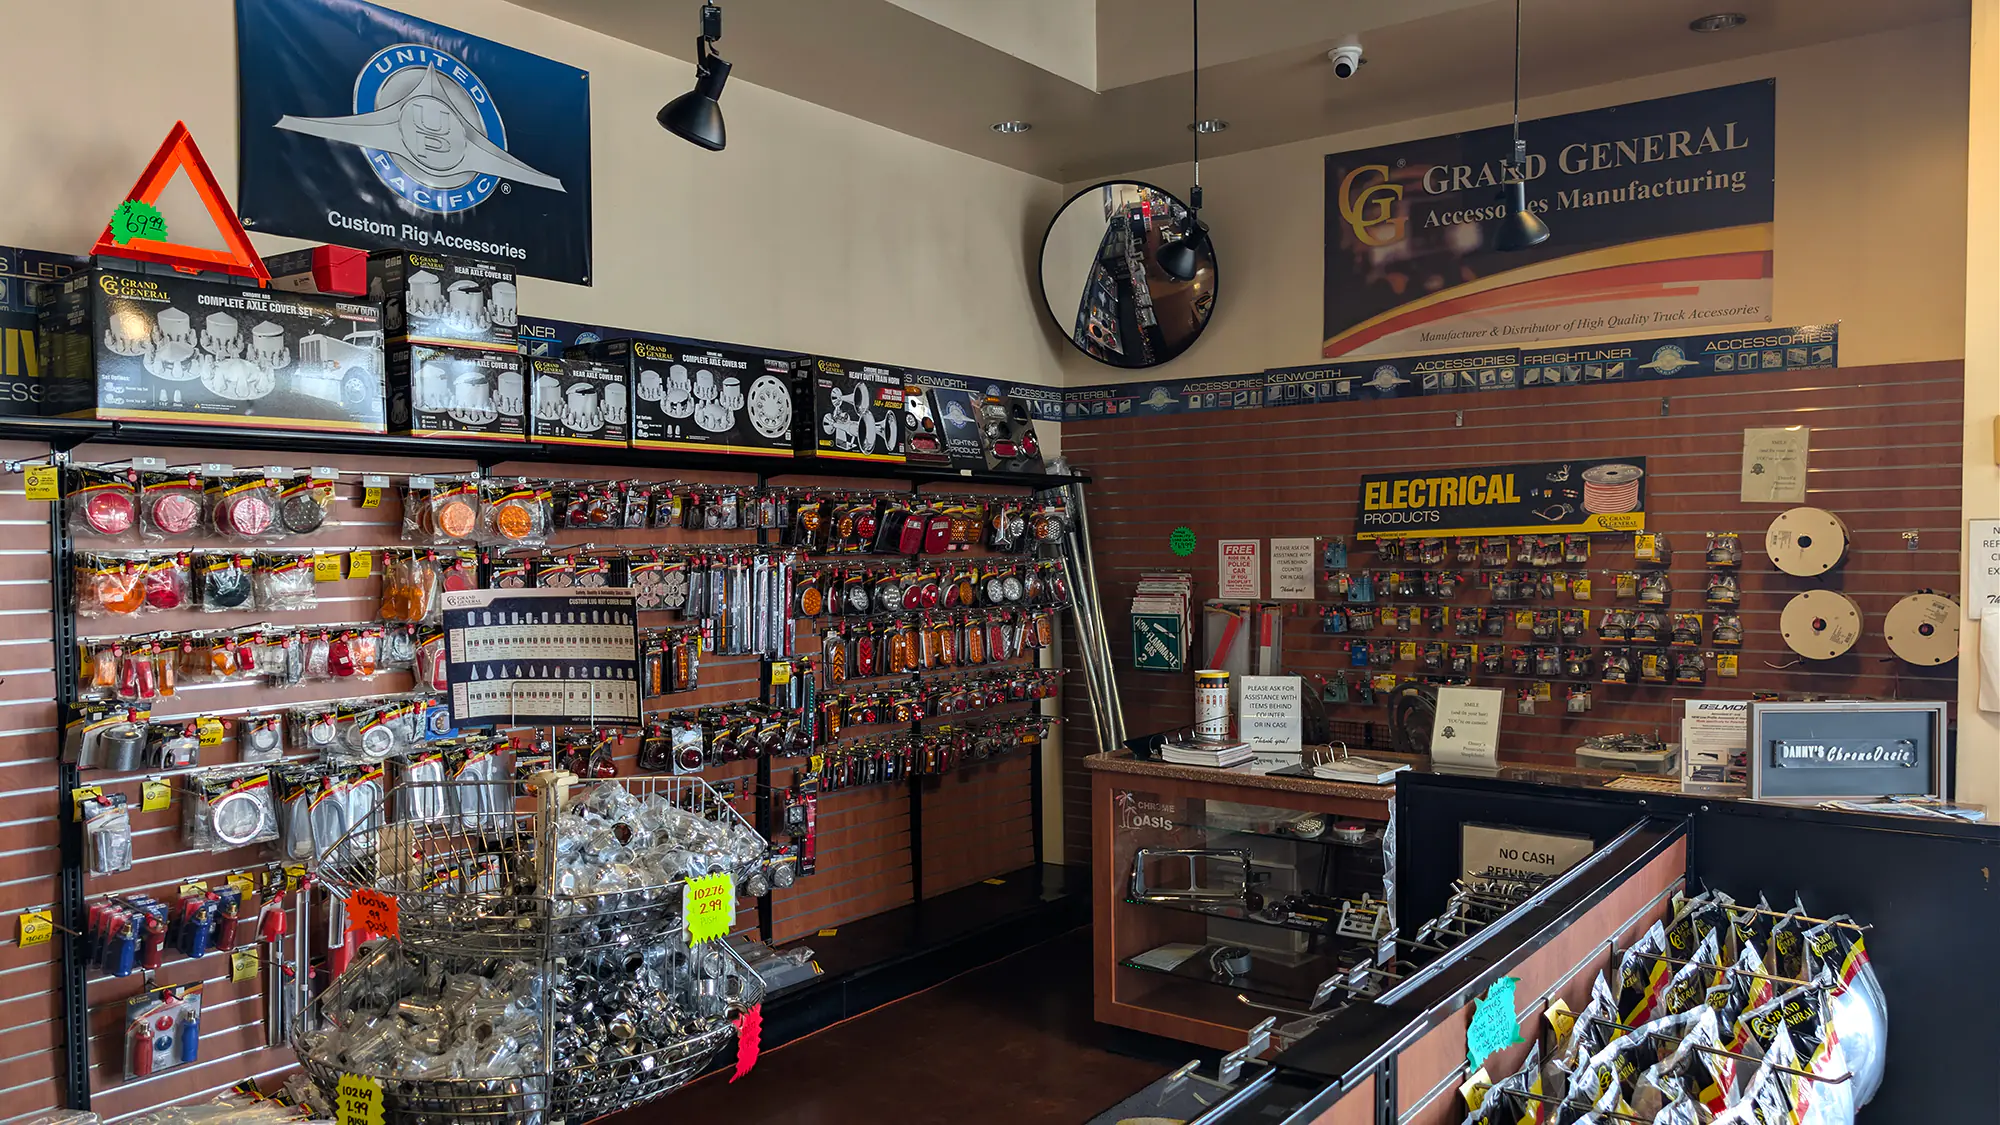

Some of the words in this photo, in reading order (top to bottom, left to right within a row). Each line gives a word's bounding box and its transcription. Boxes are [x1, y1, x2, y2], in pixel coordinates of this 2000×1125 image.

[375, 49, 485, 104] UNITED
[1558, 121, 1749, 175] GENERAL
[375, 153, 490, 207] PACIFIC
[1423, 197, 1549, 228] Accessoes
[1557, 169, 1747, 211] Manufacturing
[327, 210, 396, 237] Custom
[401, 224, 429, 246] Rig
[433, 230, 527, 260] Accessories
[24, 260, 73, 277] LED
[454, 266, 469, 274] REAR
[470, 268, 484, 277] AXLE
[484, 270, 501, 279] COVER
[502, 273, 512, 281] SET
[120, 278, 158, 290] GRAND
[120, 287, 170, 300] GENERAL
[197, 294, 244, 309] COMPLETE
[246, 299, 268, 312] AXLE
[269, 302, 297, 314] COVER
[298, 305, 314, 317] SET
[1420, 327, 1487, 342] Manufacturer
[1489, 326, 1500, 337] &
[1502, 319, 1562, 337] Distributor
[1563, 317, 1576, 332] of
[1577, 315, 1604, 331] High
[1606, 313, 1650, 328] Quality
[1653, 308, 1685, 323] Truck
[1688, 304, 1760, 320] Accessories
[646, 345, 667, 353] GRAND
[646, 351, 673, 359] GENERAL
[1523, 348, 1632, 365] FREIGHTLINER
[1704, 331, 1833, 351] ACCESSORIES
[490, 361, 508, 370] COVER
[509, 363, 518, 371] SET
[682, 354, 708, 365] COMPLETE
[709, 357, 721, 366] AXLE
[722, 358, 738, 369] COVER
[738, 360, 747, 370] SET
[1267, 368, 1342, 383] KENWORTH
[1414, 355, 1516, 371] ACCESSORIES
[572, 370, 586, 378] REAR
[586, 371, 598, 379] AXLE
[598, 373, 613, 381] COVER
[614, 374, 623, 382] SET
[917, 375, 967, 389] KENWORTH
[1010, 386, 1062, 401] ACCESSORIES
[1065, 389, 1116, 401] PETERBILT
[1183, 378, 1264, 392] ACCESSORIES
[1364, 473, 1521, 511] ELECTRICAL
[1363, 510, 1440, 525] PRODUCTS
[1225, 545, 1253, 555] FREE
[1135, 617, 1179, 668] NON-FLAMMABLE
[1144, 642, 1157, 657] GAS
[1138, 652, 1147, 664] 2
[1253, 736, 1272, 744] Thank
[1275, 737, 1289, 745] you!
[1783, 745, 1825, 759] DANNY'S
[1138, 801, 1175, 813] CHROME
[1133, 815, 1173, 831] OASIS
[1499, 848, 1518, 861] NO
[1522, 851, 1555, 865] CASH
[694, 885, 725, 900] 10276
[700, 899, 722, 914] 2.99
[1766, 1001, 1800, 1024] GRAND
[342, 1086, 372, 1101] 10269
[346, 1100, 368, 1116] 2.99
